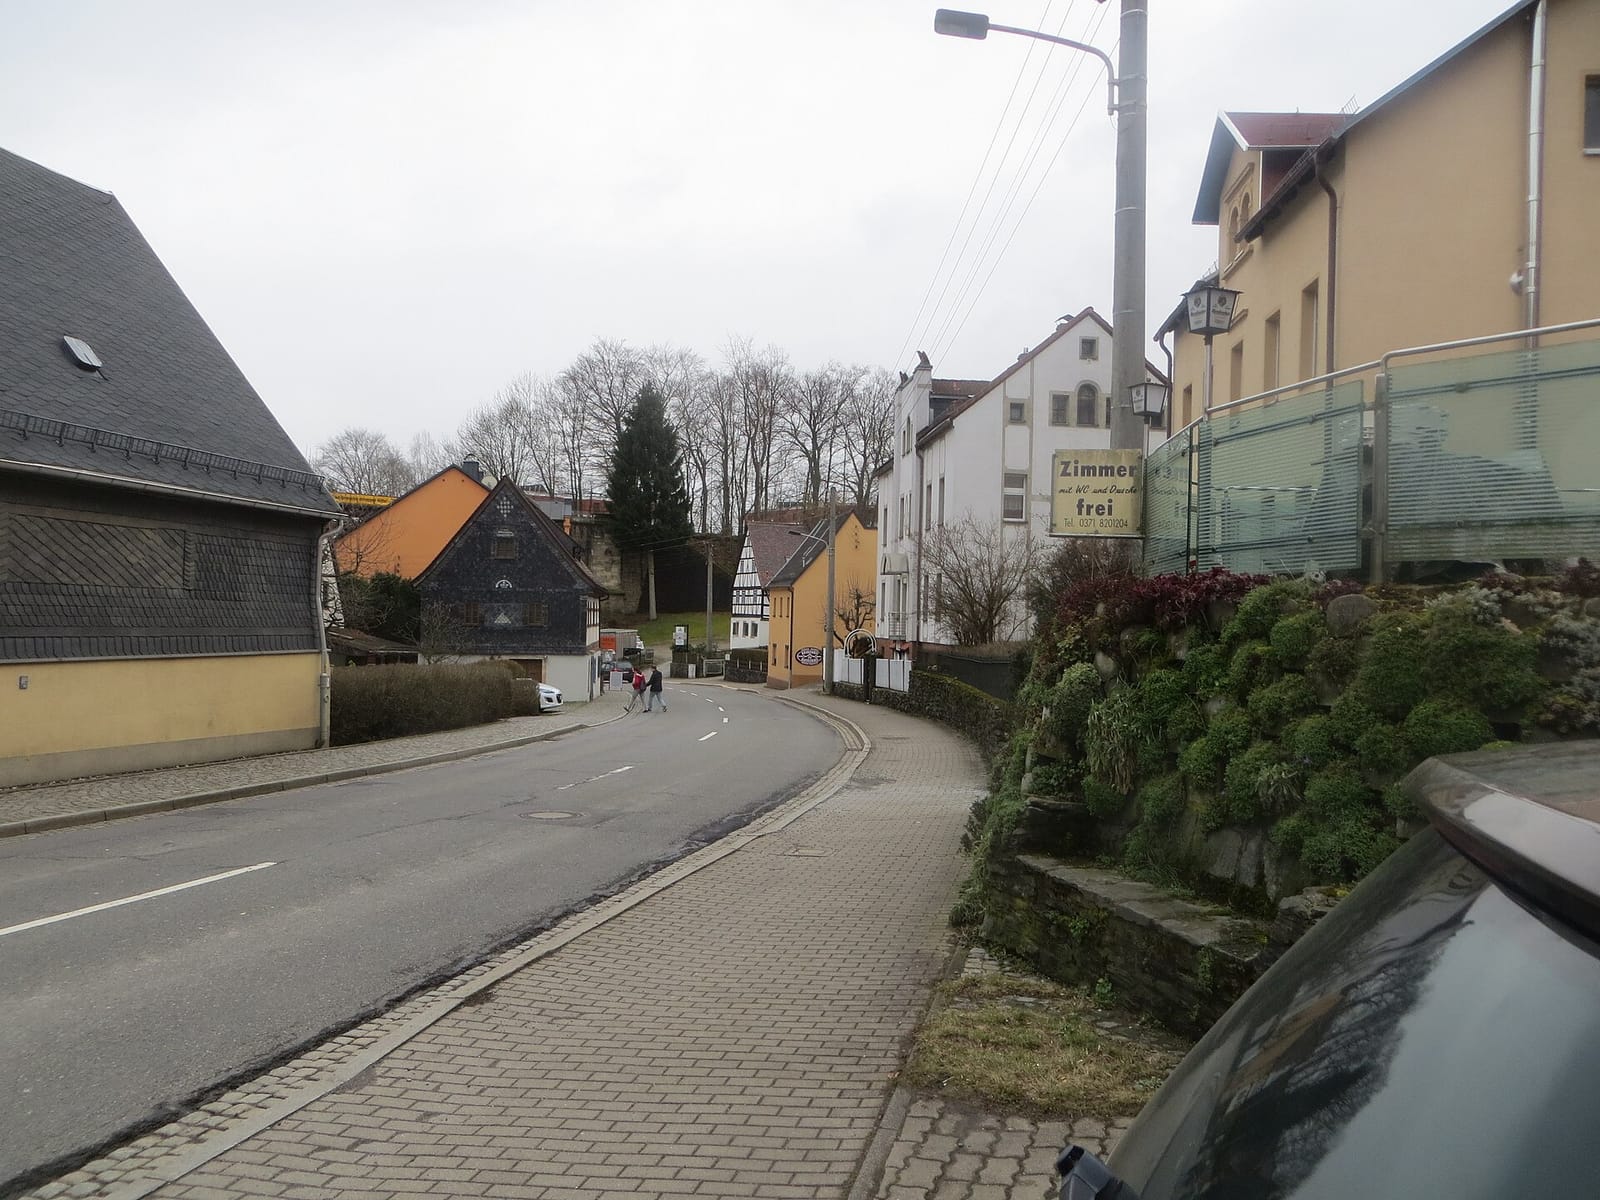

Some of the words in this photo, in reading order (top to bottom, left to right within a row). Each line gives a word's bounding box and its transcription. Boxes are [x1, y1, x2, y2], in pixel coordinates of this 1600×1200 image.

[1059, 459, 1137, 477] Zimmer
[1075, 485, 1090, 494] WC
[1091, 486, 1108, 494] und
[1109, 485, 1137, 494] Dusche
[1076, 498, 1113, 516] frei
[1079, 518, 1095, 527] 0371
[1099, 518, 1128, 528] 8201204
